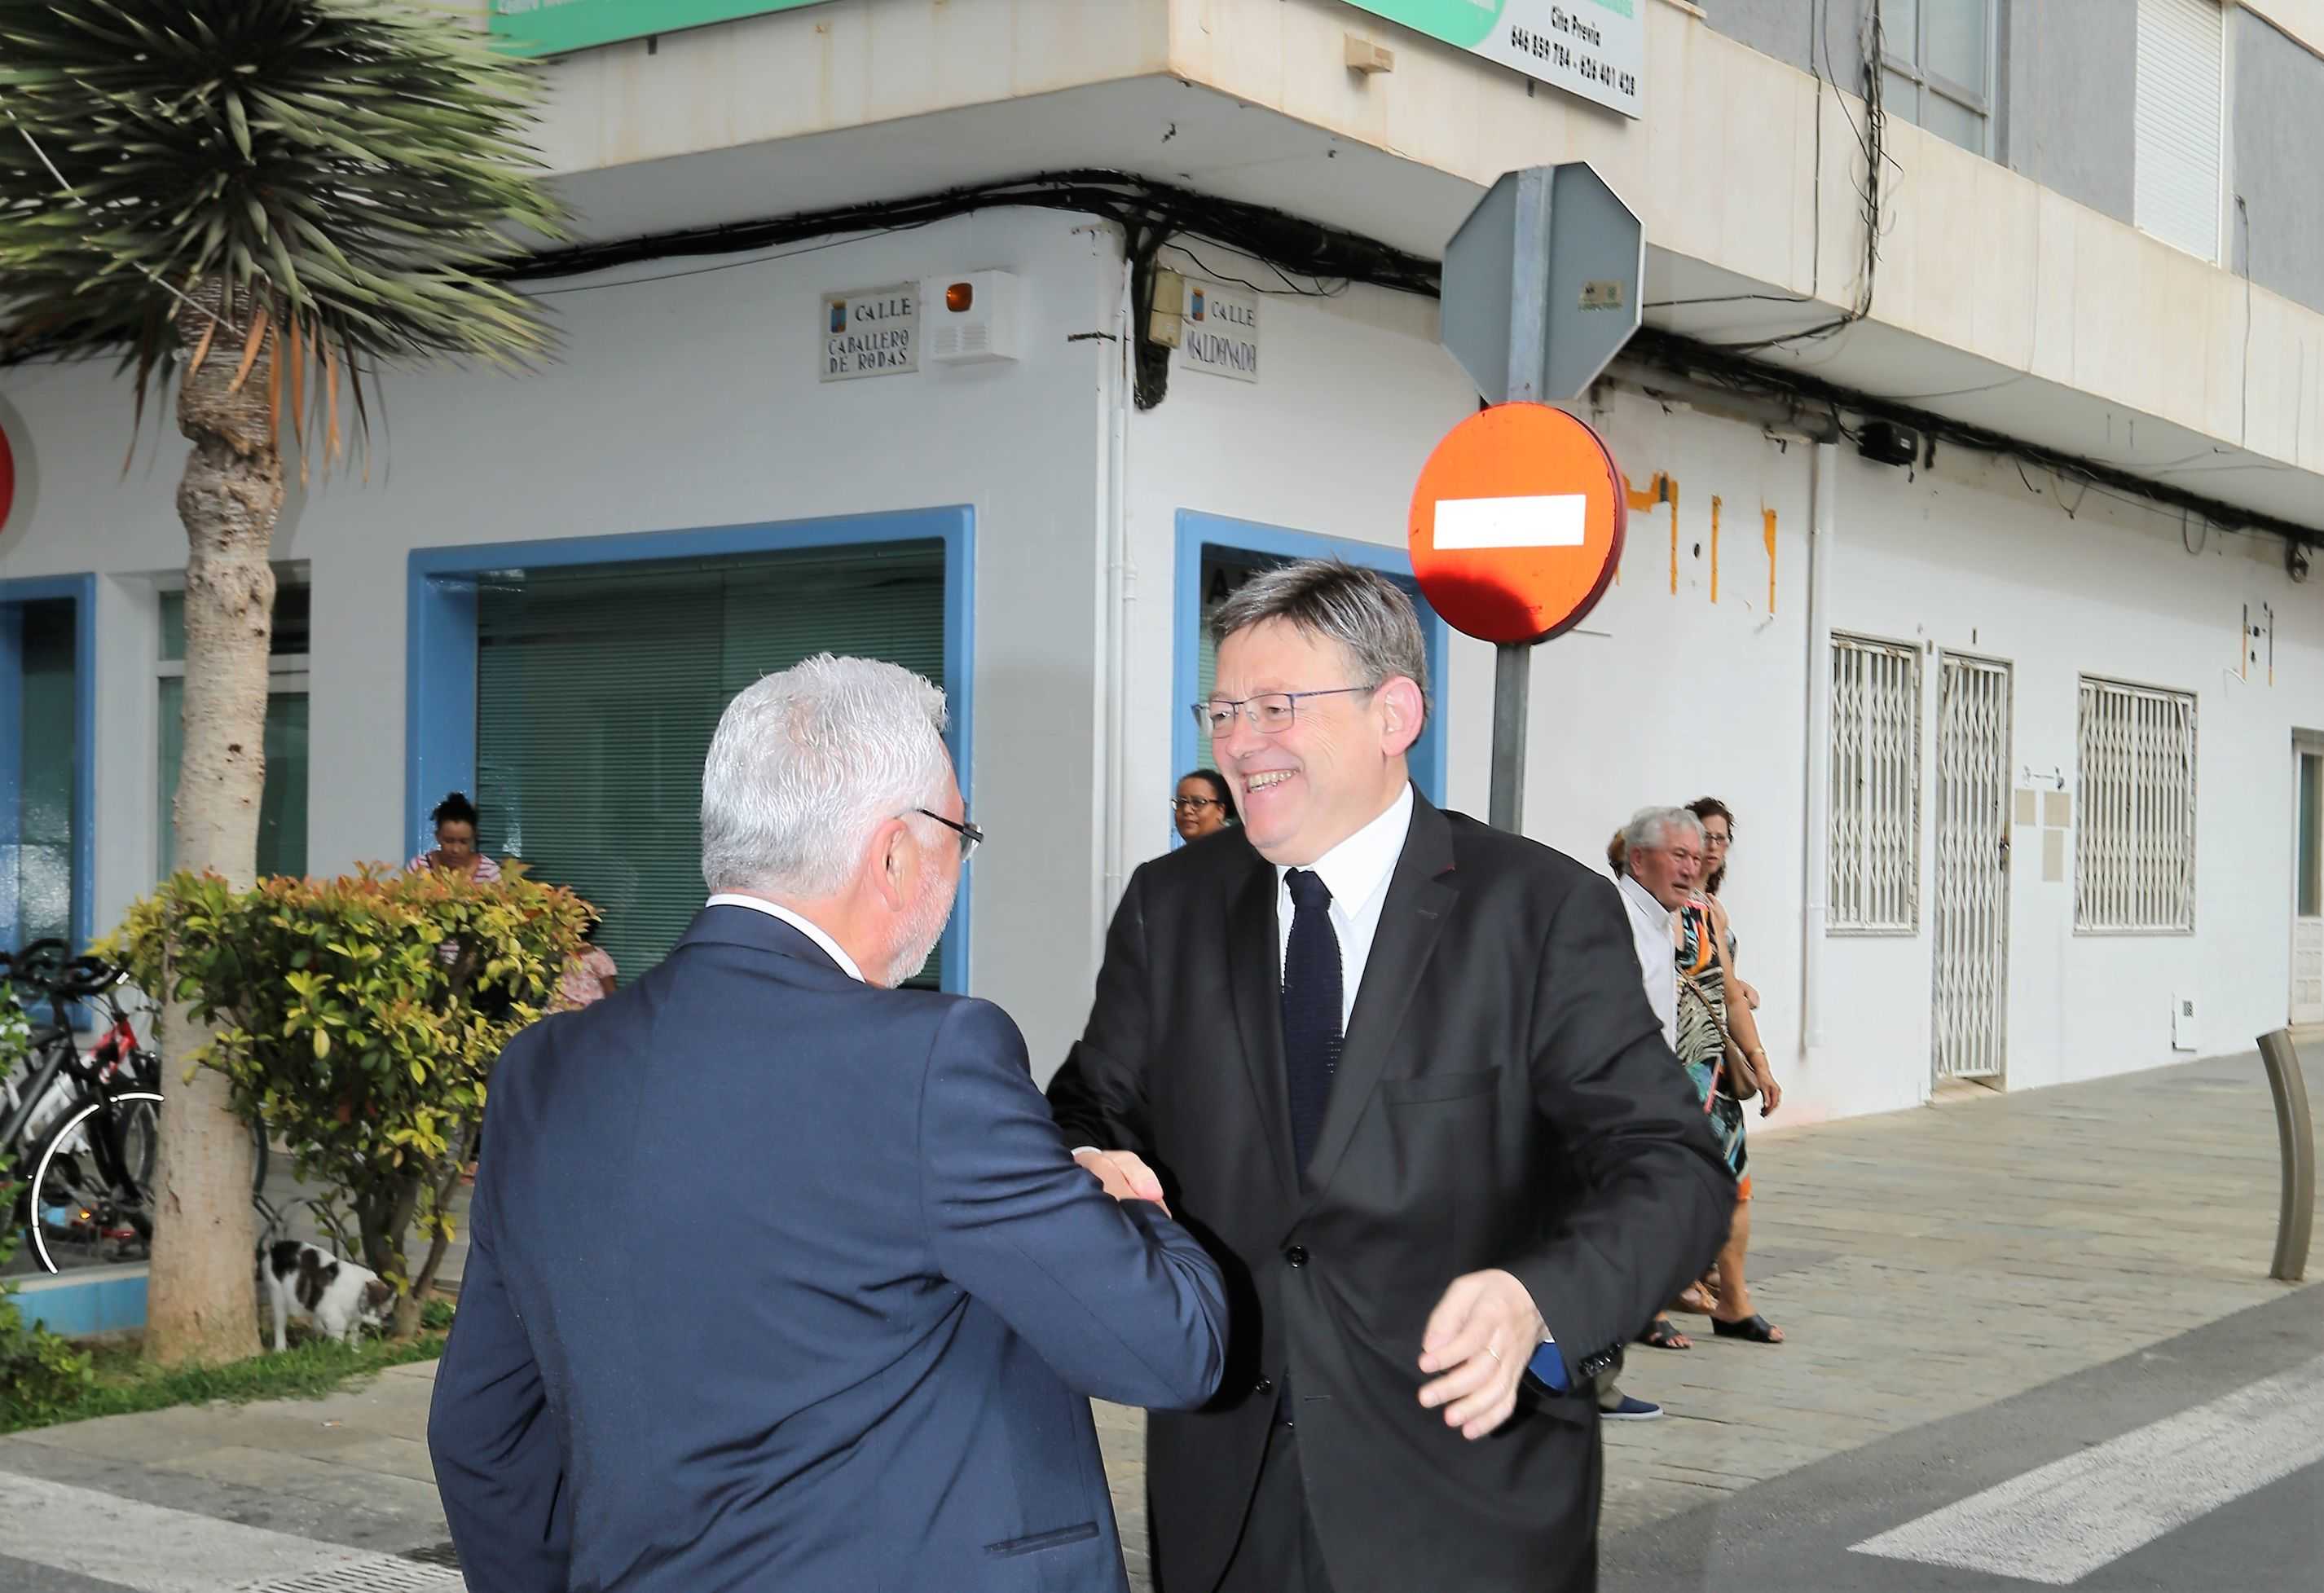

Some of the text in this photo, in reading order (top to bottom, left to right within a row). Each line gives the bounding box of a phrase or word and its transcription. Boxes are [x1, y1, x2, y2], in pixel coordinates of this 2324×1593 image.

[1552, 5, 1569, 33] Cita
[1571, 13, 1602, 47] Previa
[856, 298, 912, 321] CALLE
[1211, 300, 1256, 328] CALLE
[828, 329, 909, 355] CABALLERO
[830, 347, 907, 373] DE RODAS
